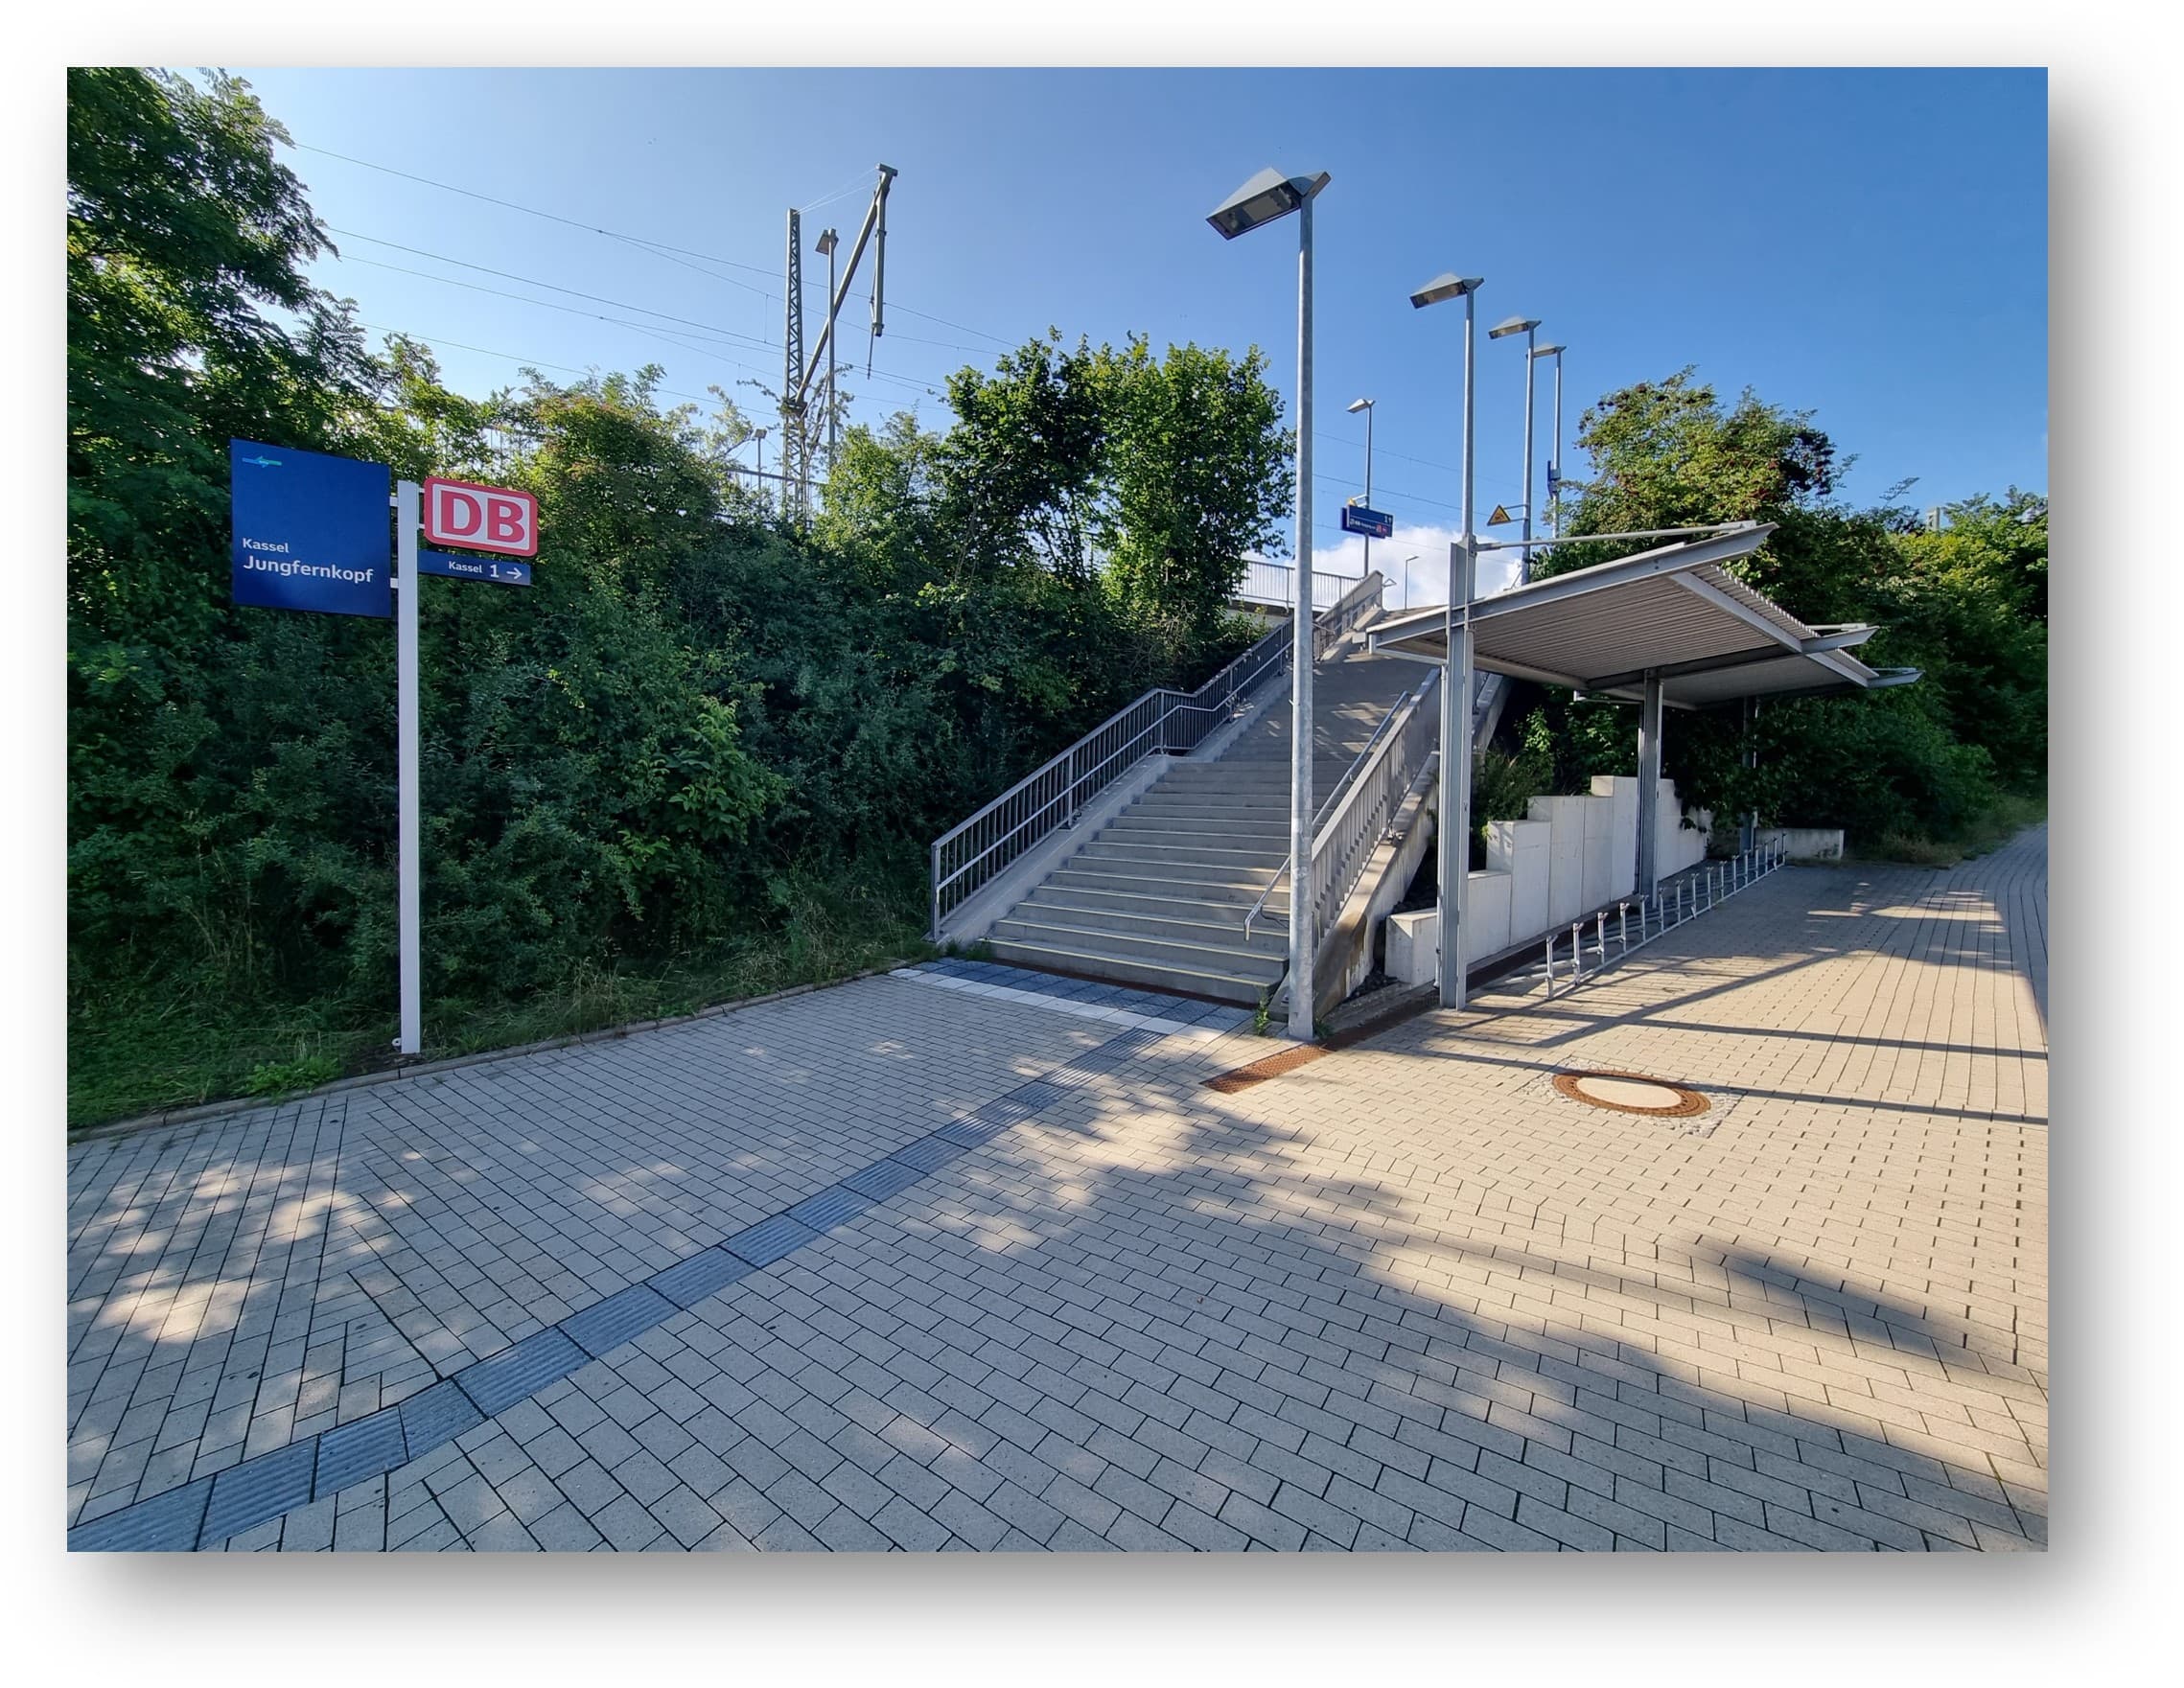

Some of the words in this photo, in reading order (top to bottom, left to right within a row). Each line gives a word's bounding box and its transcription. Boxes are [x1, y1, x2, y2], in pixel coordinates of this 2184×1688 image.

[441, 490, 525, 543] DB
[243, 538, 290, 553] Kassel
[244, 556, 374, 584] Jungfernkopf
[448, 561, 482, 573] Kassel
[490, 564, 500, 578] 1
